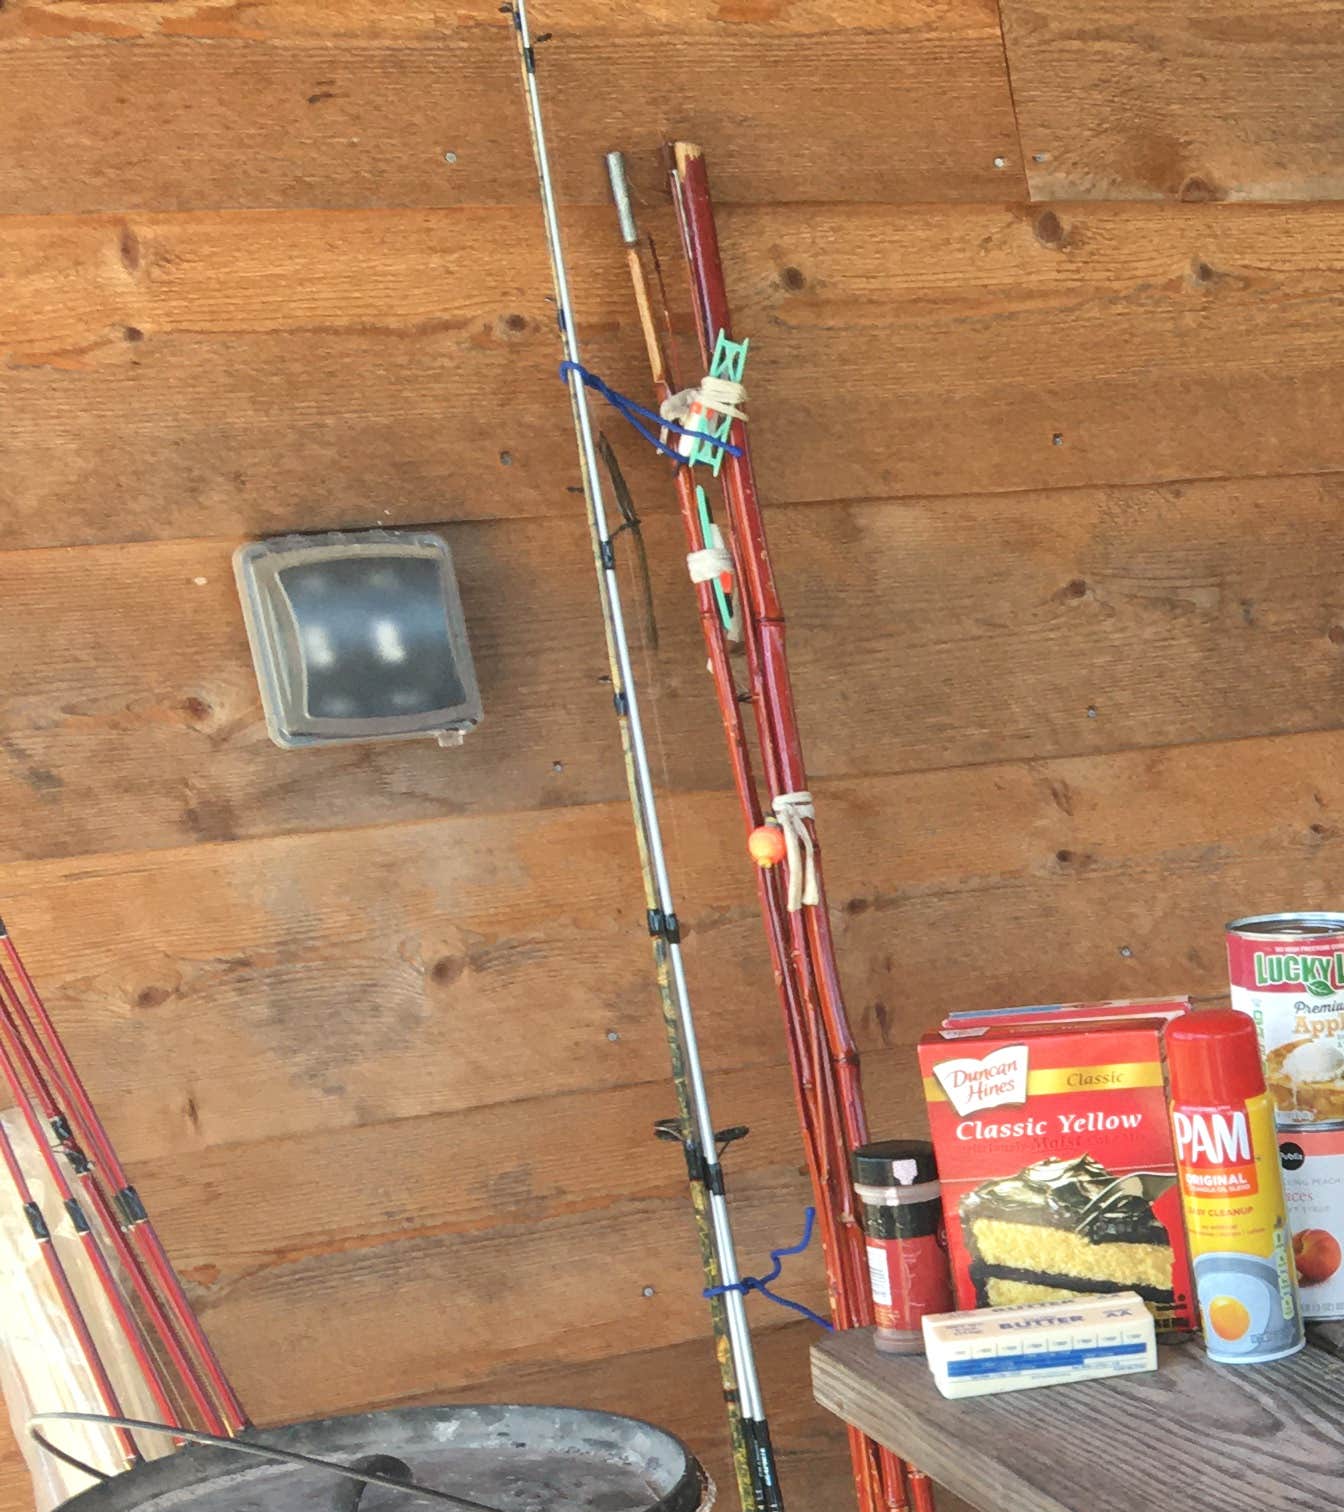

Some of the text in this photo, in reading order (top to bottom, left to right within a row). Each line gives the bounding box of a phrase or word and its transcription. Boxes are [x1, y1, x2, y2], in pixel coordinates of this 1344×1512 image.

[1254, 952, 1333, 986] LUCKY
[946, 1060, 1018, 1089] Duncan
[1066, 1070, 1124, 1087] Classic
[967, 1079, 1016, 1104] Hines
[956, 1111, 1143, 1141] Classic Yellow
[1172, 1110, 1252, 1165] PAM
[999, 1314, 1085, 1331] BUTTER
